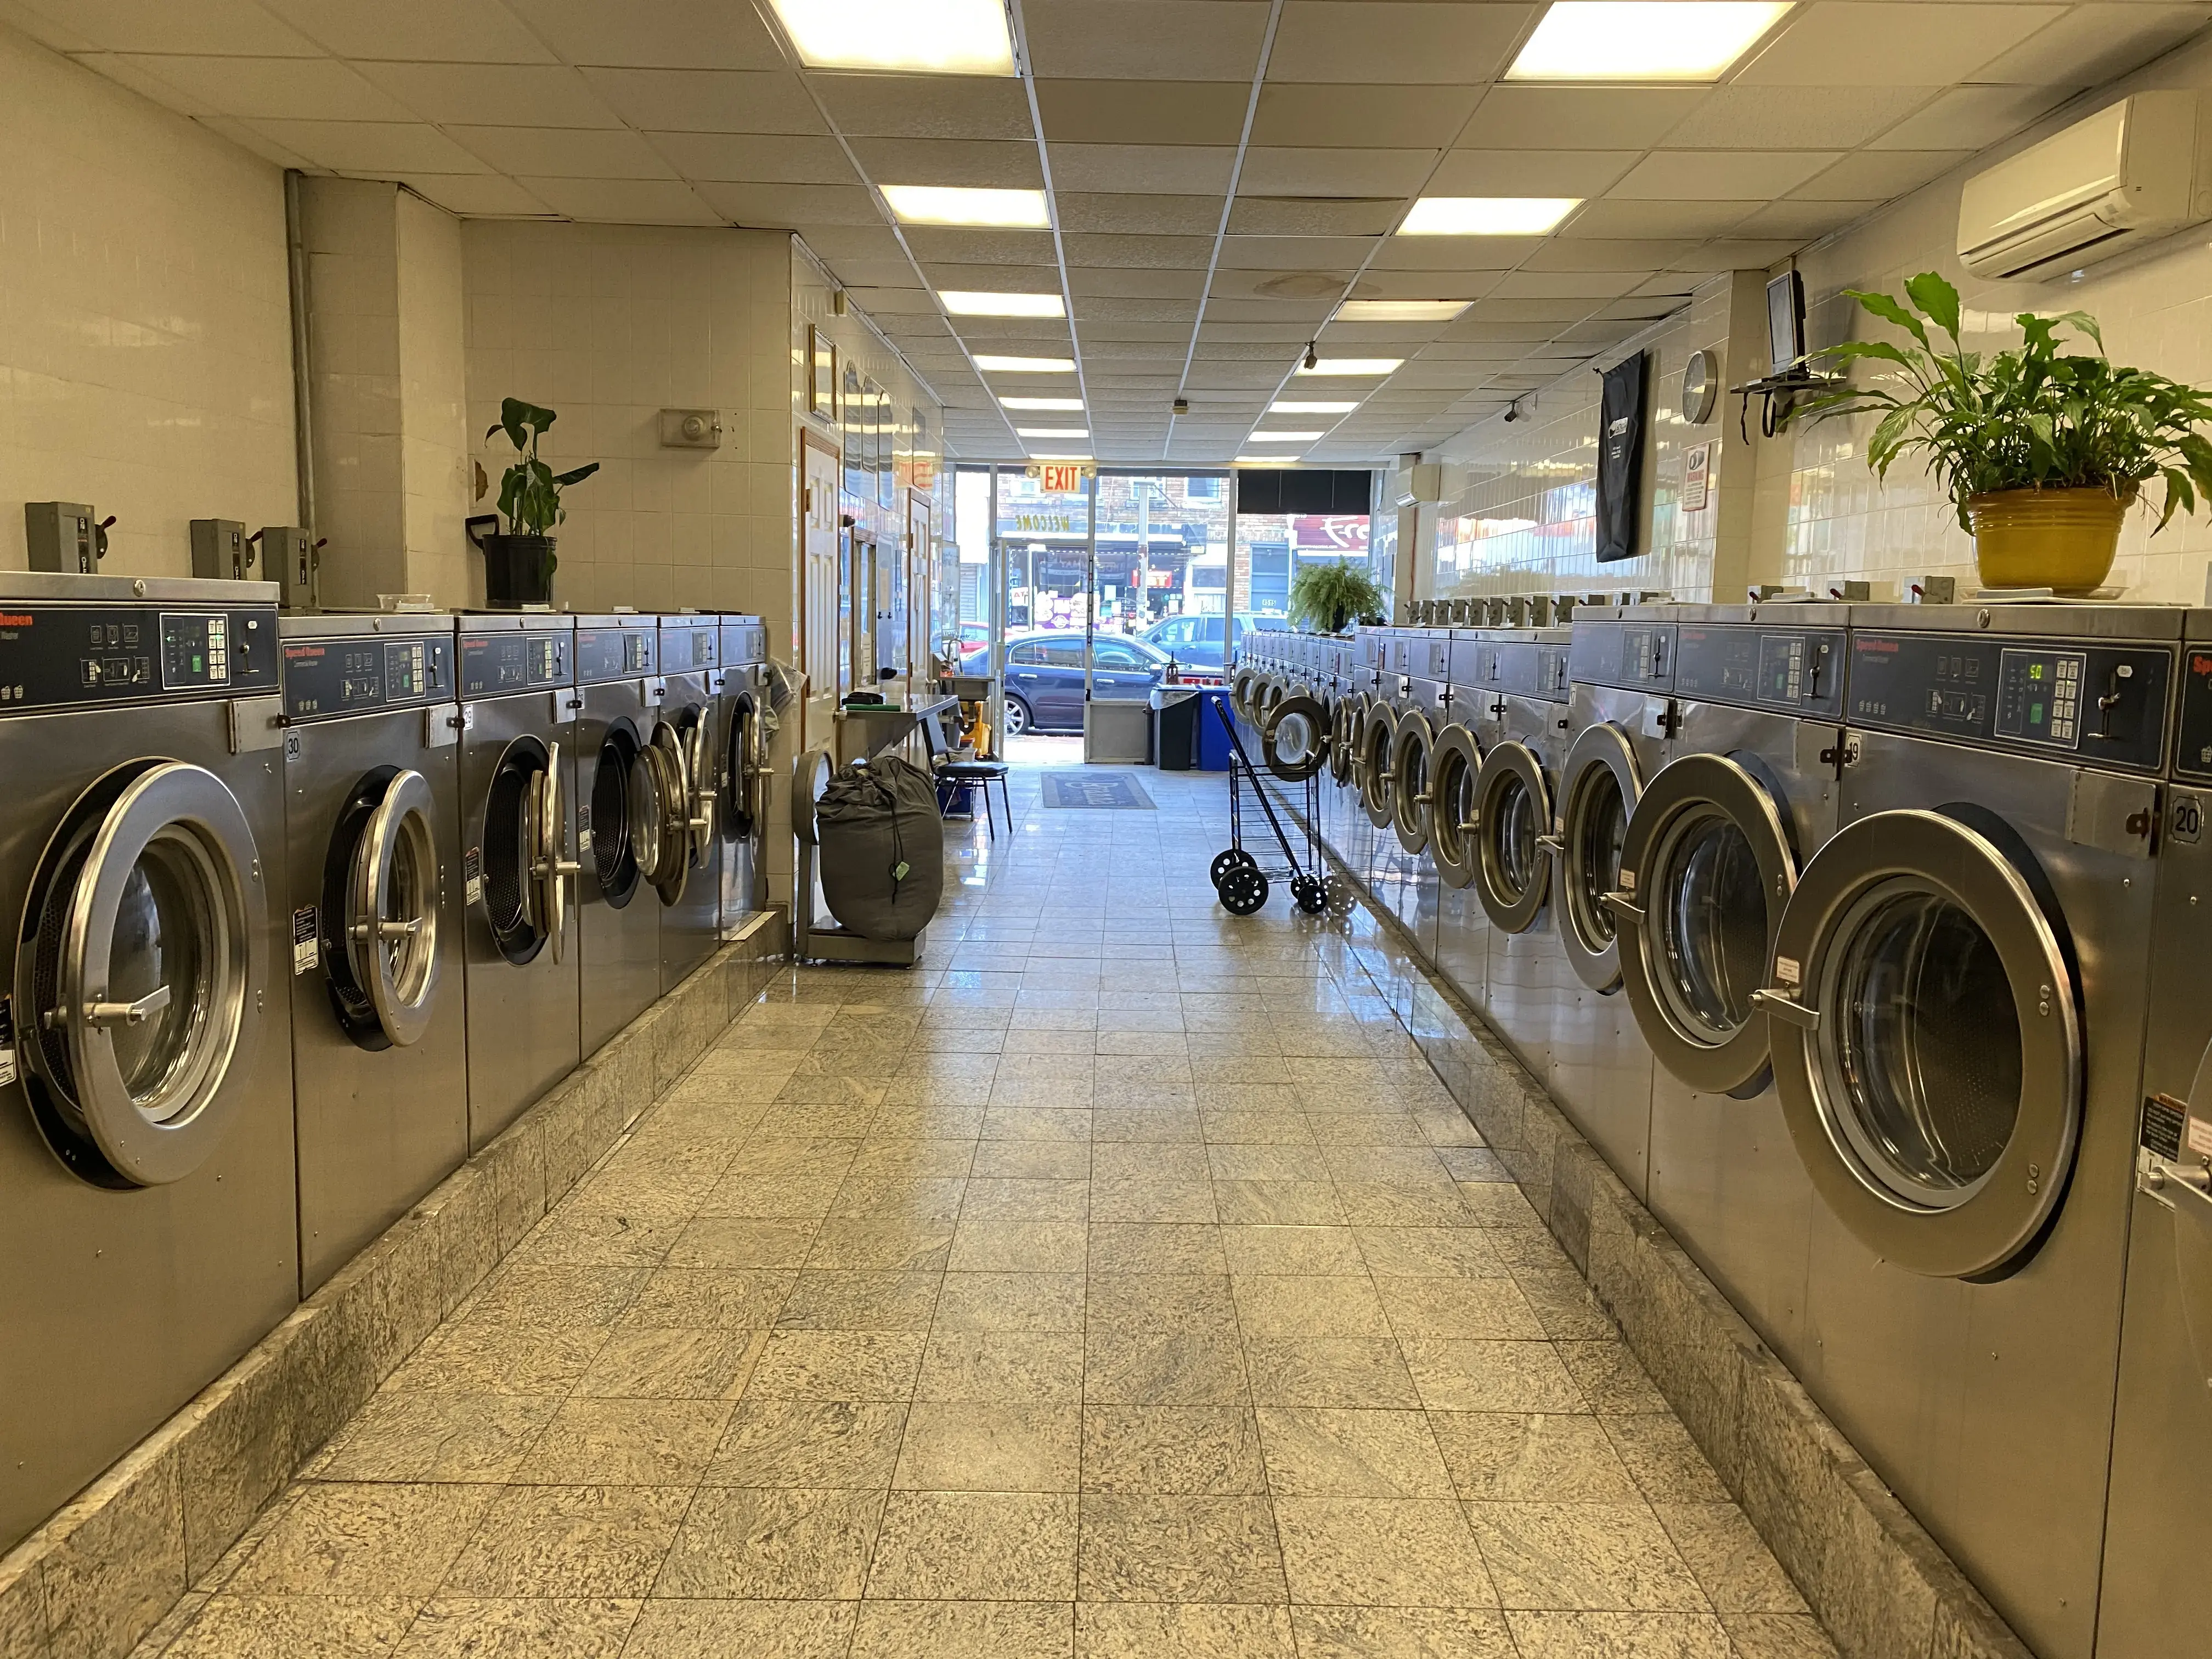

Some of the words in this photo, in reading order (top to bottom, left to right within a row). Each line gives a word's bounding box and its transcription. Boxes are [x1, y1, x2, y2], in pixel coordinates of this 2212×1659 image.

[1045, 466, 1077, 490] EXIT
[2193, 656, 2212, 675] Sp
[464, 710, 471, 724] 29
[288, 737, 299, 754] 30
[1849, 742, 1859, 760] 19
[2175, 806, 2199, 834] 20
